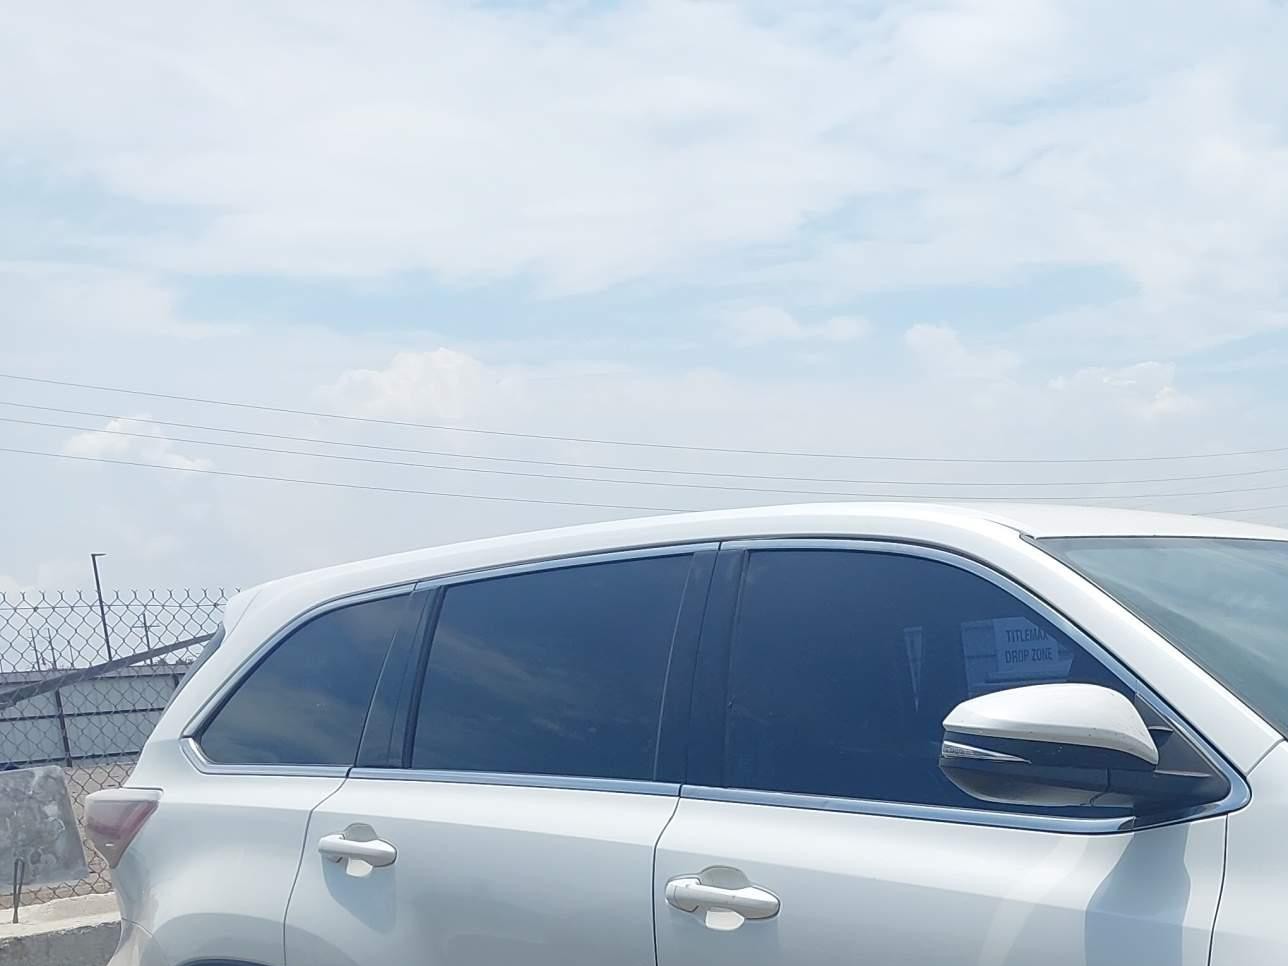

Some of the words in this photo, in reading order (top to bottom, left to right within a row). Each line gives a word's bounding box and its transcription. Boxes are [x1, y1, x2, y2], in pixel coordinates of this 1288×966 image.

[1006, 628, 1048, 643] TITLEMAX
[1005, 649, 1029, 664] DROP
[1032, 648, 1052, 661] ZONE
